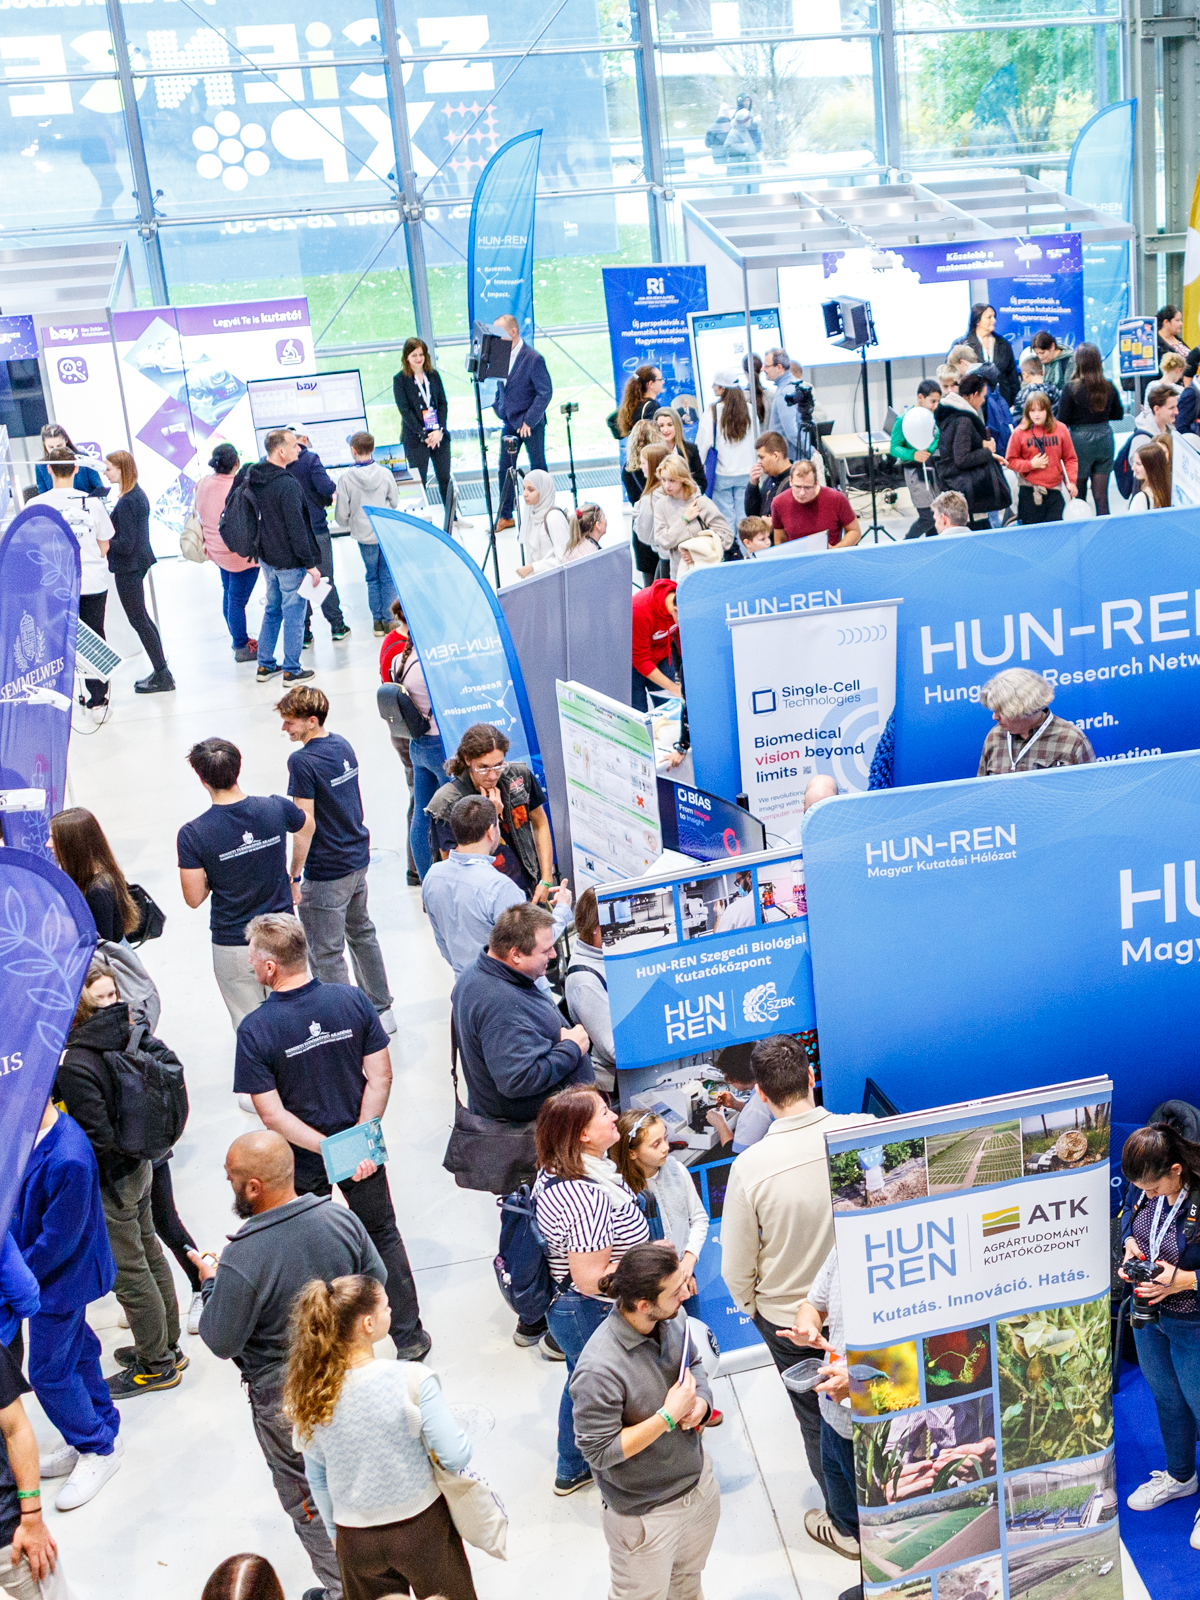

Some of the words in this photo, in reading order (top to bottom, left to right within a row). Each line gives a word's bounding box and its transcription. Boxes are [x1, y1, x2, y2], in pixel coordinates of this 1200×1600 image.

[477, 235, 528, 245] HUN-REN
[946, 251, 985, 261] Közelebb
[646, 277, 665, 295] Ri
[635, 336, 685, 346] Magyarországon
[296, 382, 317, 391] bay
[725, 588, 842, 619] HUN-REN
[1, 656, 65, 700] SEMMELWEIS
[1043, 658, 1142, 687] Research
[782, 679, 861, 697] Single-Cell
[783, 693, 861, 708] Technologies
[754, 727, 842, 749] Biomedical
[755, 749, 800, 766] vision
[804, 742, 864, 759] beyond
[756, 766, 798, 783] limits
[759, 801, 784, 813] imaging
[786, 798, 800, 807] with
[771, 790, 805, 802] revolutioni
[679, 804, 694, 815] From
[679, 812, 686, 820] to
[760, 810, 790, 821] computer
[866, 823, 1016, 866] HUN-REN
[867, 862, 912, 879] Magyar
[916, 854, 968, 873] Kutatási
[971, 848, 1017, 866] Hálózat
[636, 954, 698, 979] HUN-REN
[700, 945, 749, 970] Szegedi
[752, 932, 807, 956] Biológiai
[675, 956, 772, 986] Kutatóközpont
[664, 991, 725, 1024] HUN
[766, 995, 796, 1011] SZBK
[667, 1012, 727, 1045] REN
[1027, 1196, 1089, 1225] ATK
[864, 1217, 956, 1262] HUN
[983, 1226, 1089, 1254] AGRÁRTUDOMÁNYI
[983, 1239, 1081, 1266] KUTATÓKÖZPONT
[867, 1248, 957, 1295] REN
[872, 1298, 942, 1325] Kutatás.
[948, 1278, 1033, 1307] Innováció.
[1038, 1268, 1090, 1287] Hatás.
